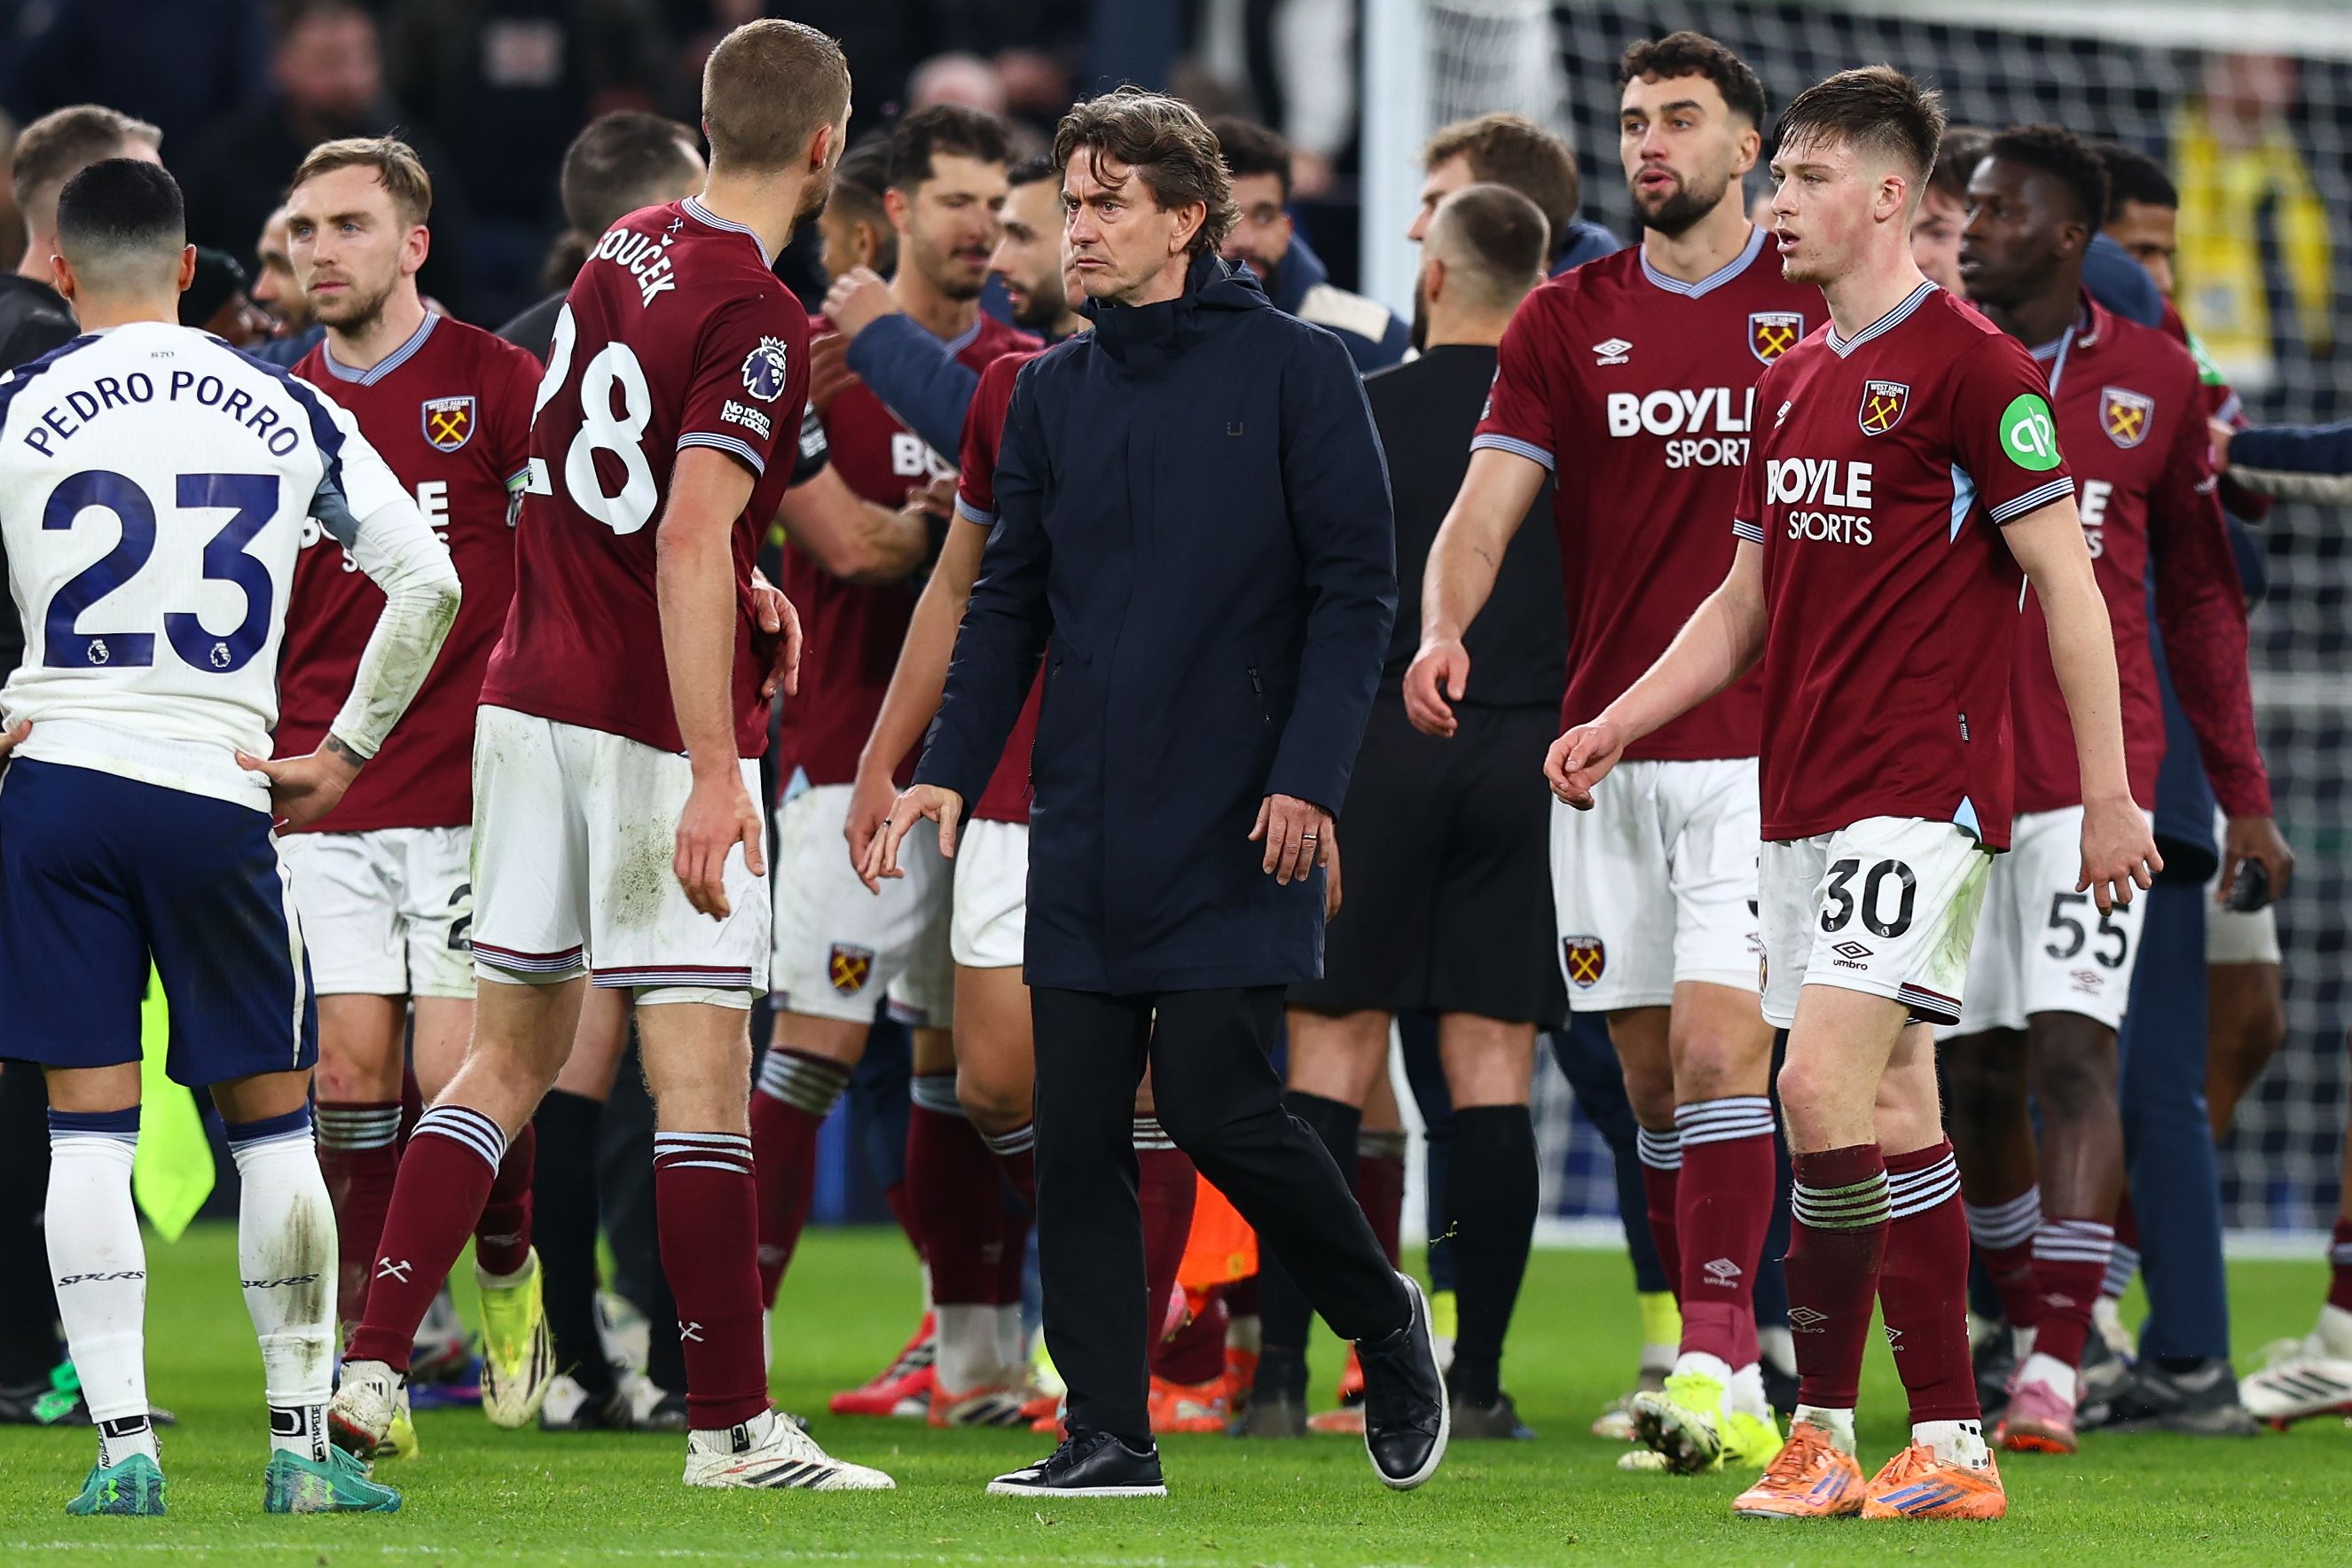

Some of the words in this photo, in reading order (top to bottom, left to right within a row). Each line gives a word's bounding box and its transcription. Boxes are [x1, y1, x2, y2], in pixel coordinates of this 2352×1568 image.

[23, 372, 154, 459] PEDRO
[169, 371, 300, 458] PORRO
[725, 399, 744, 415] No
[743, 407, 771, 429] room
[1665, 437, 1751, 469] SPORT
[1766, 457, 1873, 510] BOYLE
[1787, 510, 1873, 546] SPORTS
[42, 469, 281, 674] 23
[1821, 858, 1917, 939] 30
[2043, 891, 2130, 969] 55
[1832, 959, 1869, 971] umbro
